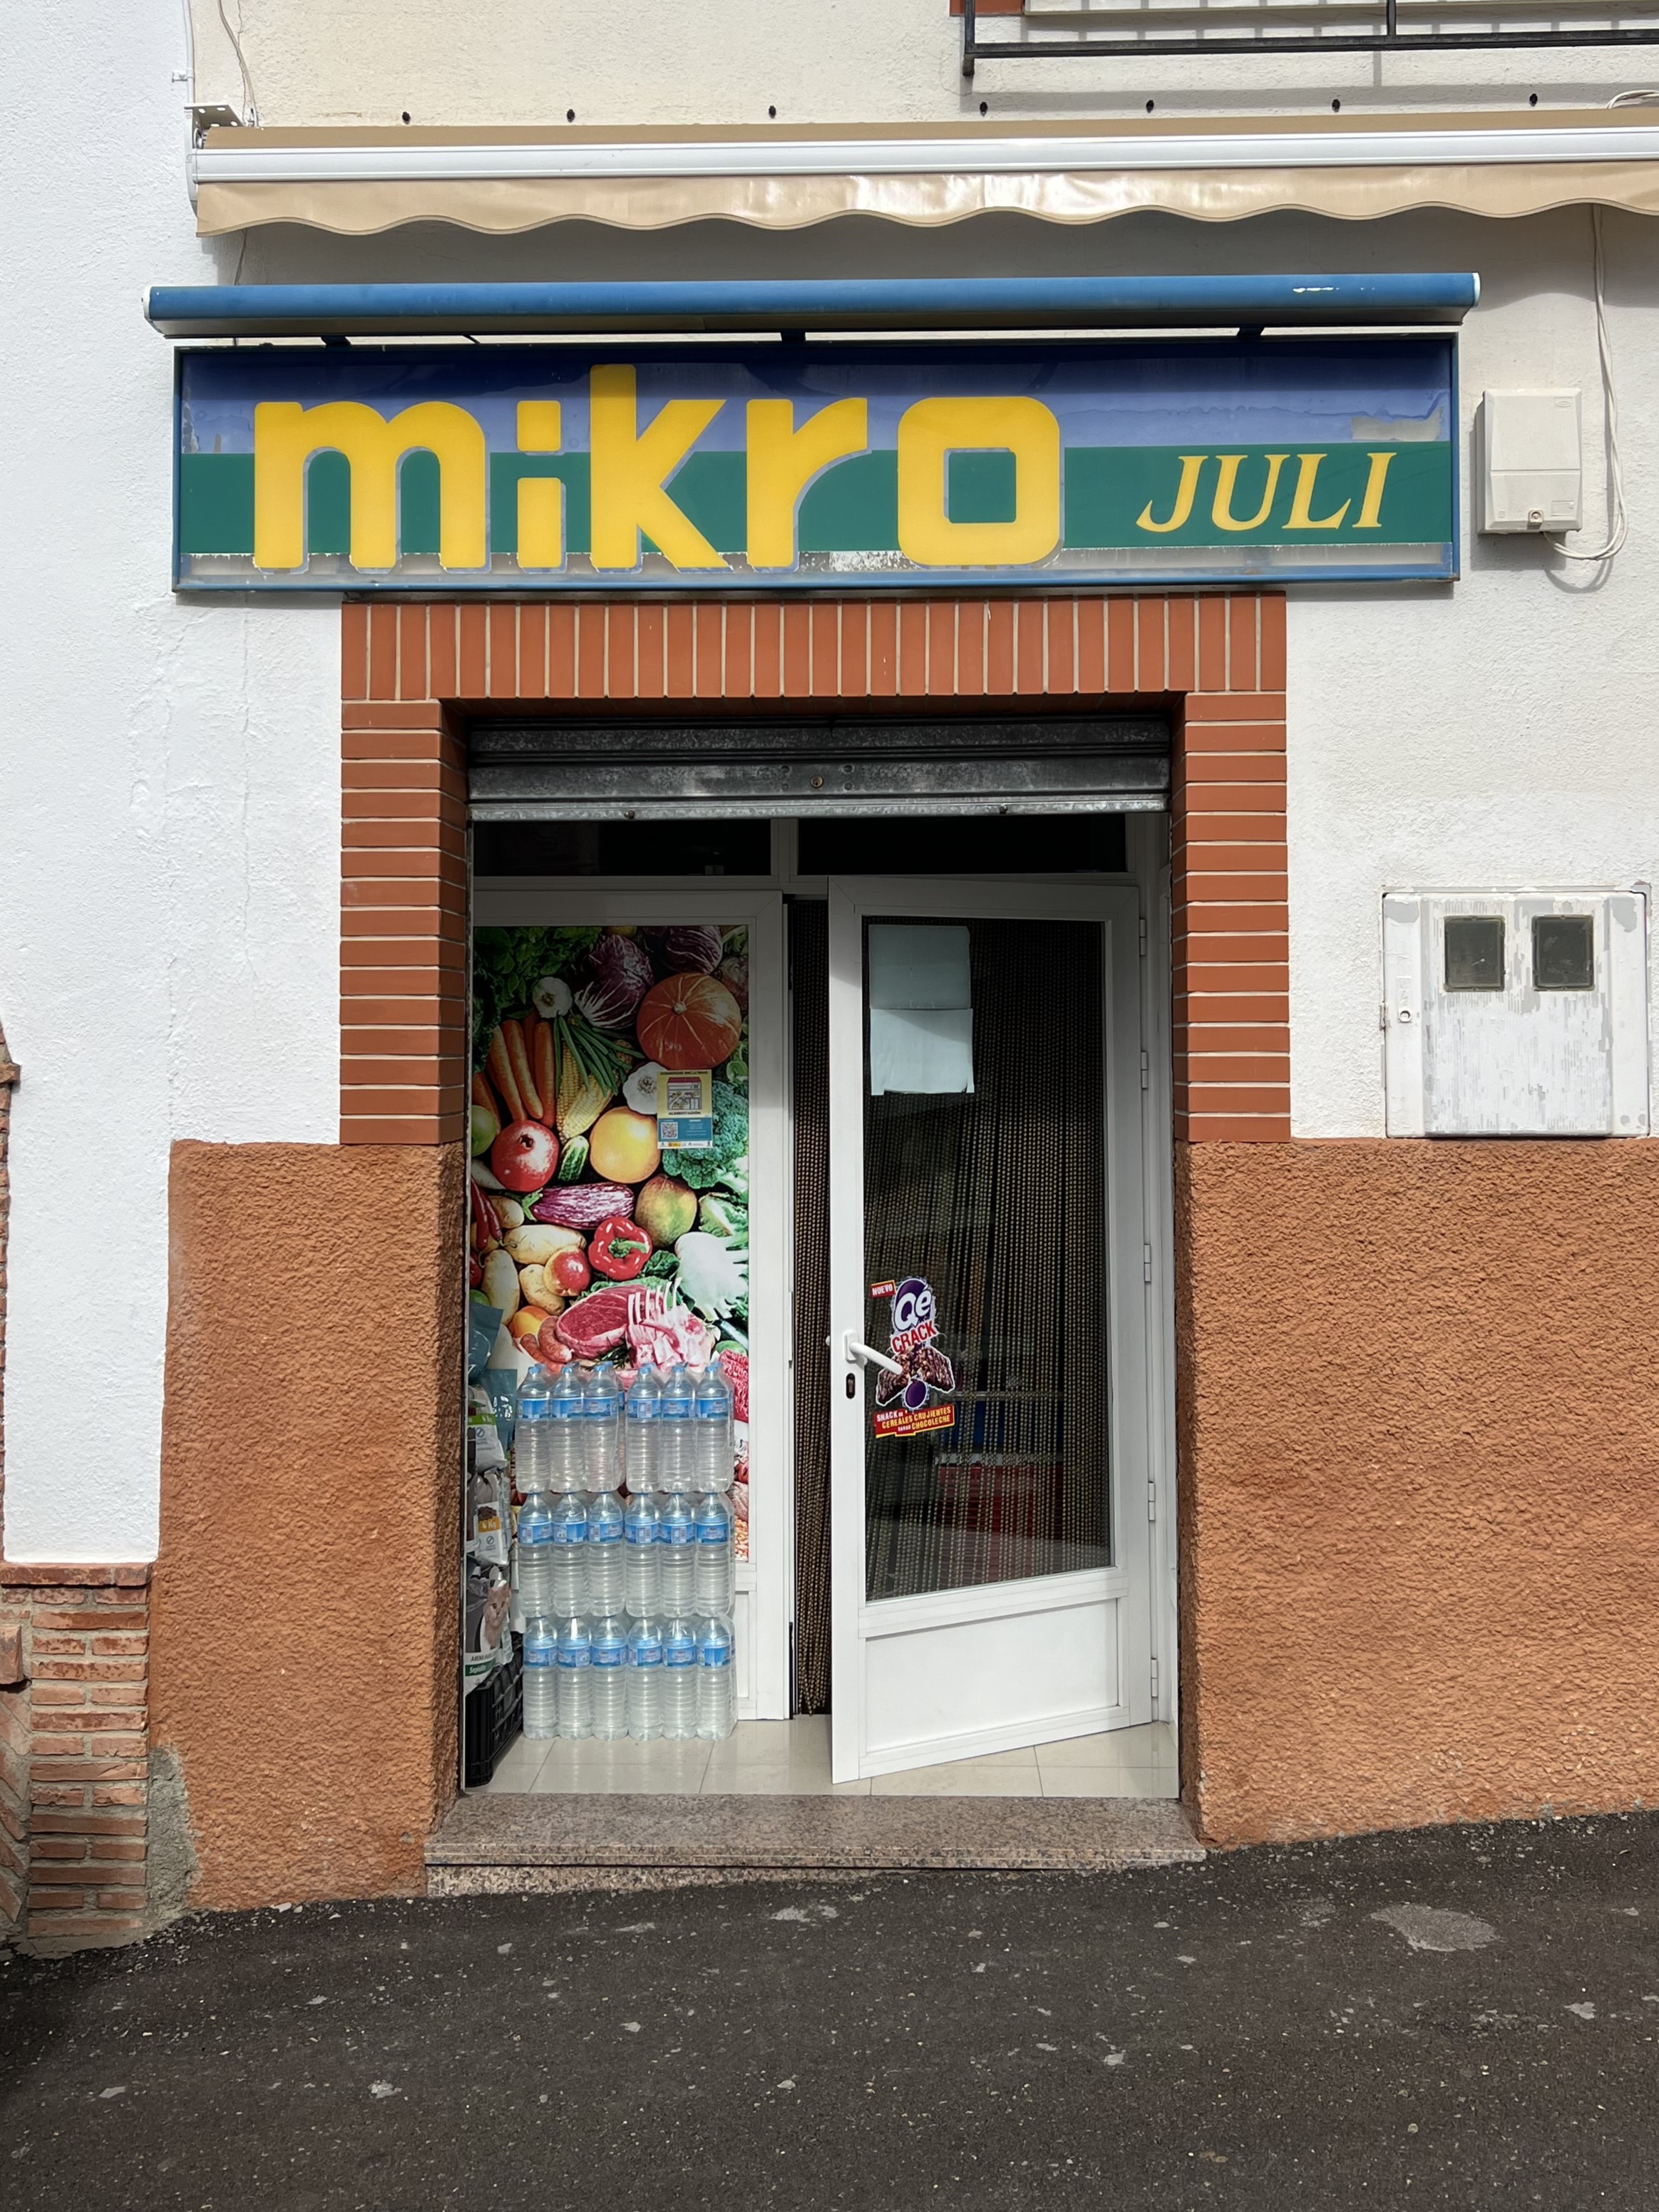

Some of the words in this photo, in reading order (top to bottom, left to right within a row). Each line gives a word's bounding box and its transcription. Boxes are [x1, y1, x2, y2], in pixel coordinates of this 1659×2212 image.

[254, 364, 1061, 570] mikro
[1136, 451, 1397, 533] JULI
[871, 1283, 893, 1297] NUEVO
[895, 1283, 933, 1331] Qé
[891, 1320, 937, 1354] CRACK
[876, 1410, 898, 1422] SNACK
[881, 1415, 913, 1429] CEREALES
[913, 1406, 951, 1421] CRUJIENTES
[911, 1415, 950, 1430] CHOCOLECHE
